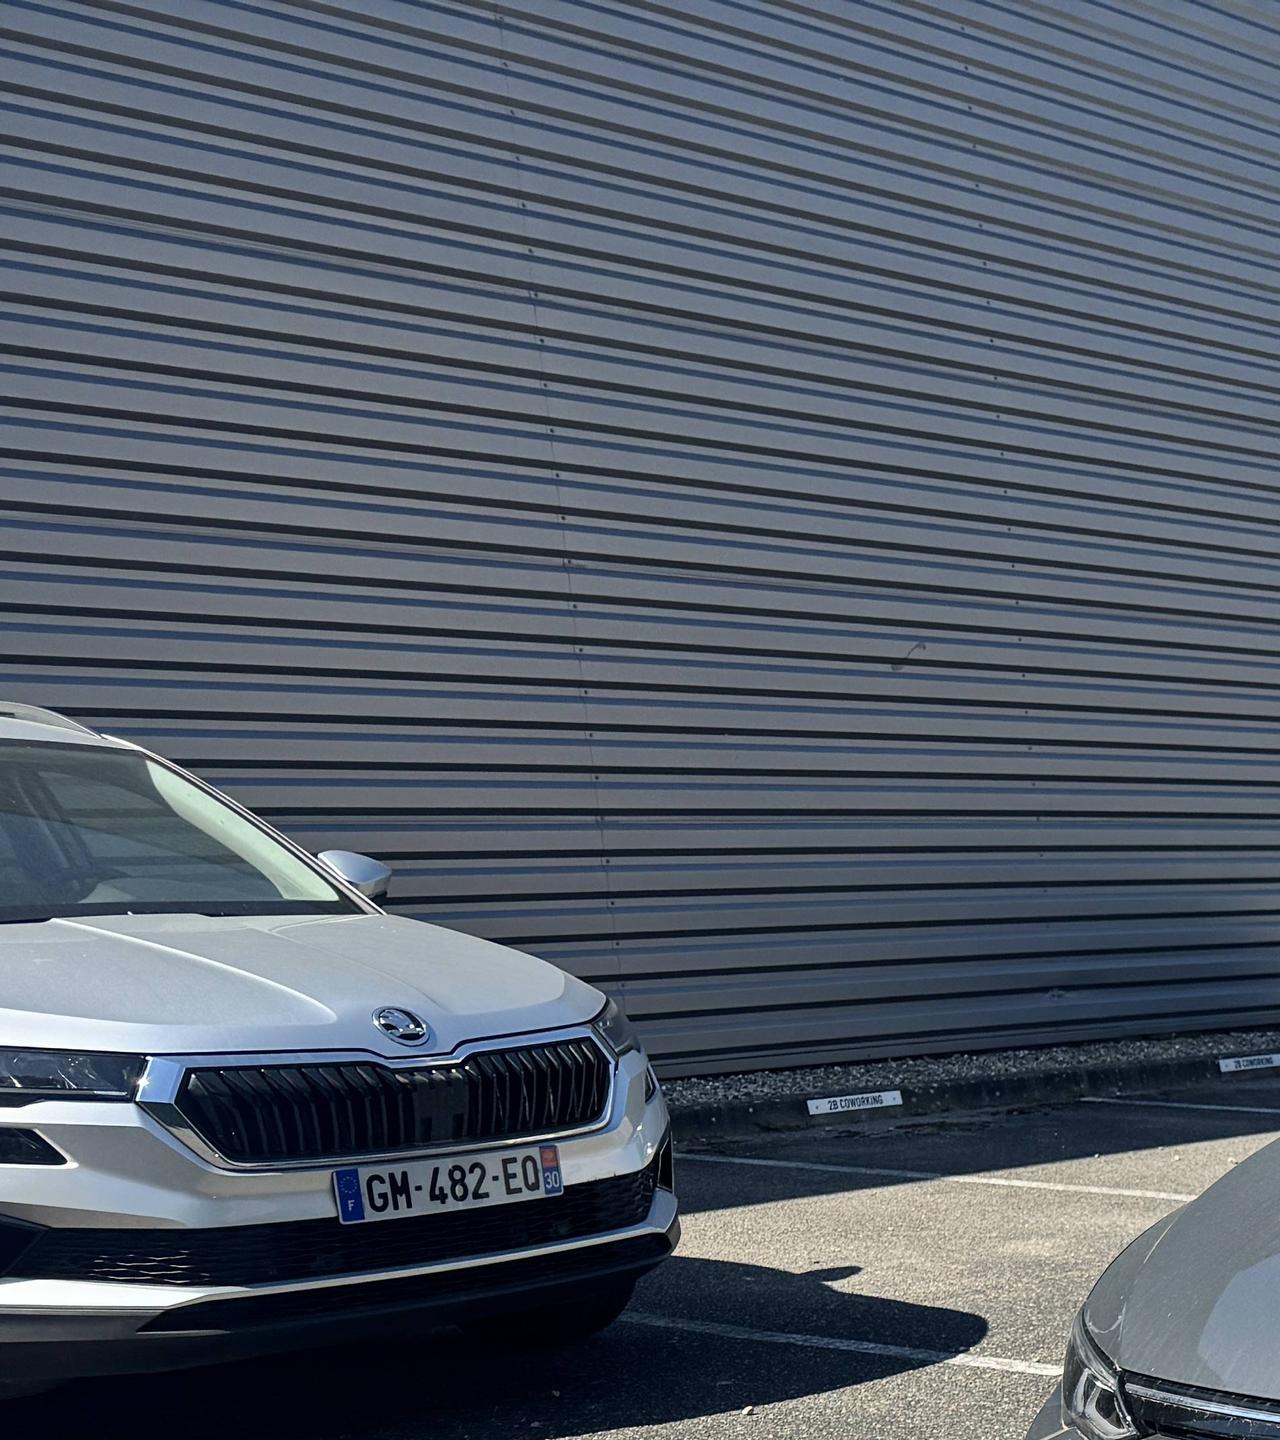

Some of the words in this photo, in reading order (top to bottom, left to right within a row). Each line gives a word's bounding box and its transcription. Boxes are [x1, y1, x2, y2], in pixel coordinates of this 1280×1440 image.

[840, 1094, 884, 1109] COWORKING
[366, 1154, 541, 1213] GM-482-EQ
[544, 1170, 561, 1189] 30
[347, 1199, 355, 1212] F
